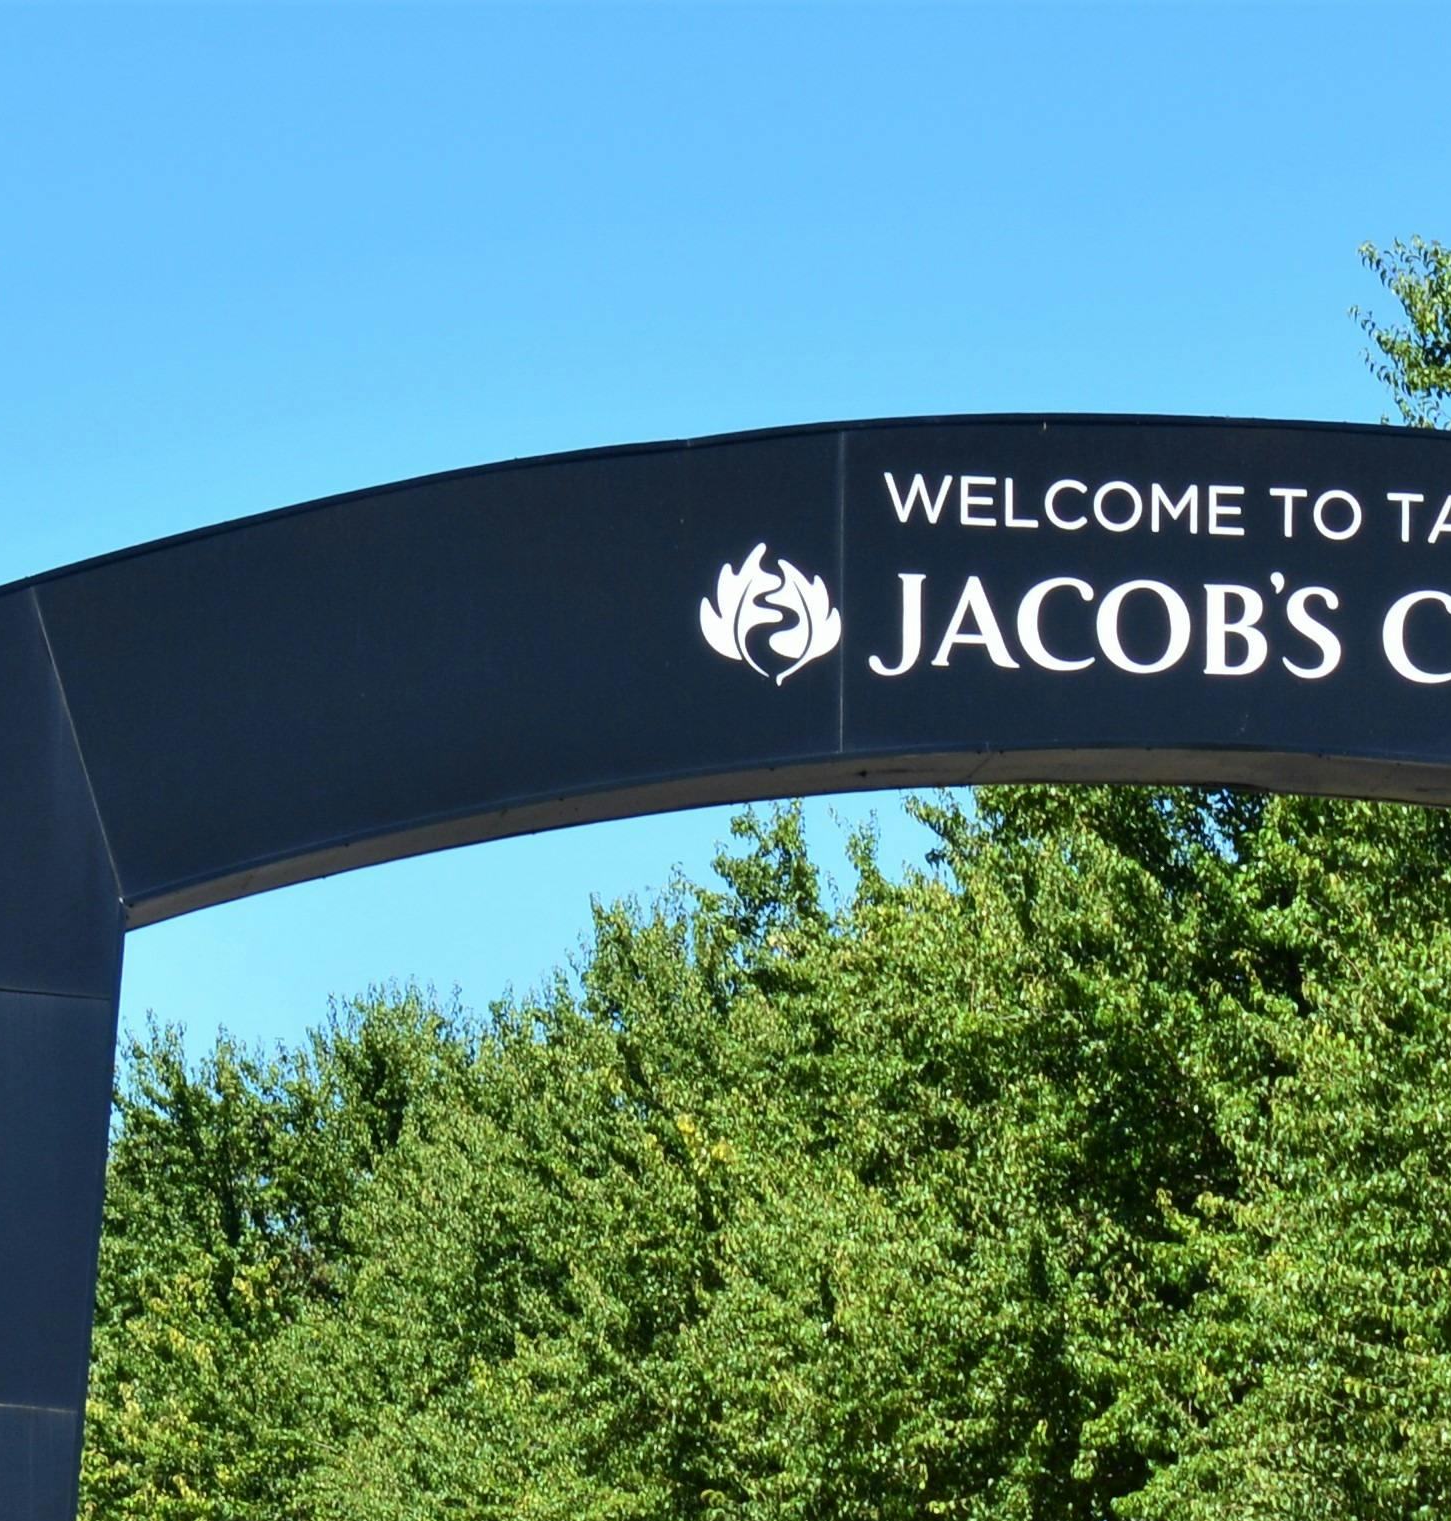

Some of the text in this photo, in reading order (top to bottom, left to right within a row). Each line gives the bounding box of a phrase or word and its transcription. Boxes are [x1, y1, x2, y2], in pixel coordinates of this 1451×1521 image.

[883, 472, 1245, 536] WELCOME
[1269, 487, 1362, 541] TO
[868, 571, 1342, 680] JACOB'S
